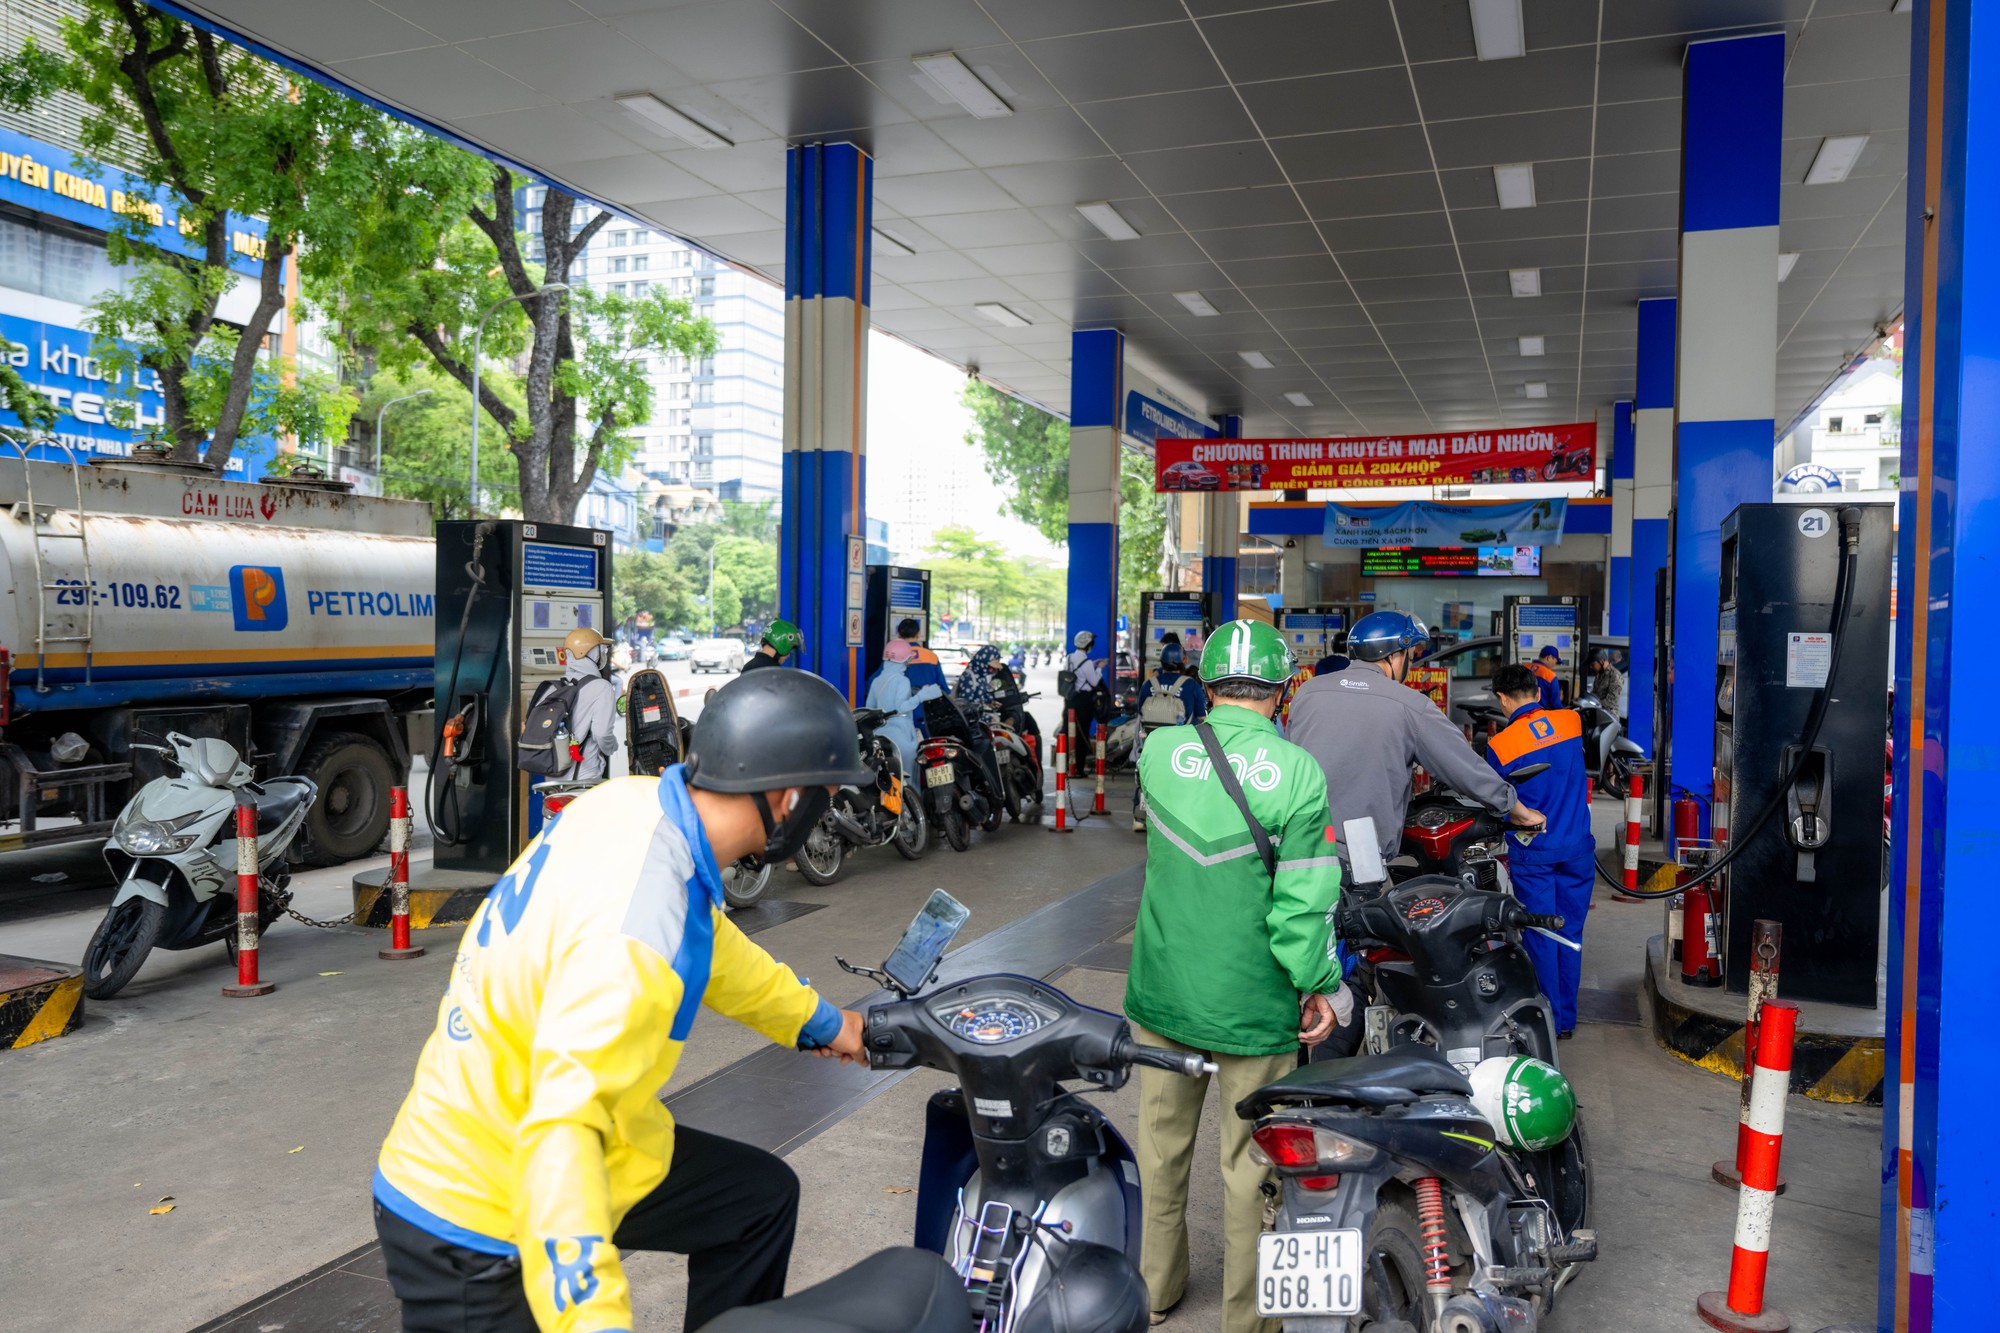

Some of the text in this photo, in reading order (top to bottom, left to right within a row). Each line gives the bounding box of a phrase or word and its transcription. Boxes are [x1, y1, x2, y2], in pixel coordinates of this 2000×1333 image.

[53, 169, 107, 210] KHOA
[1192, 430, 1553, 462] CHƯƠNG TRÌNH KHUYẾN MẠI DẦU NHỜN
[1291, 459, 1441, 477] GIẢM GIÁ 20K/HỘP
[525, 526, 535, 537] 20
[1803, 516, 1823, 531] 21
[595, 534, 605, 544] 19
[307, 591, 436, 616] PETROLIM
[1507, 1081, 1519, 1117] GRAB
[1296, 1215, 1332, 1224] HONDA
[1272, 1235, 1342, 1271] 29-H1
[1263, 1273, 1352, 1310] 968.10
